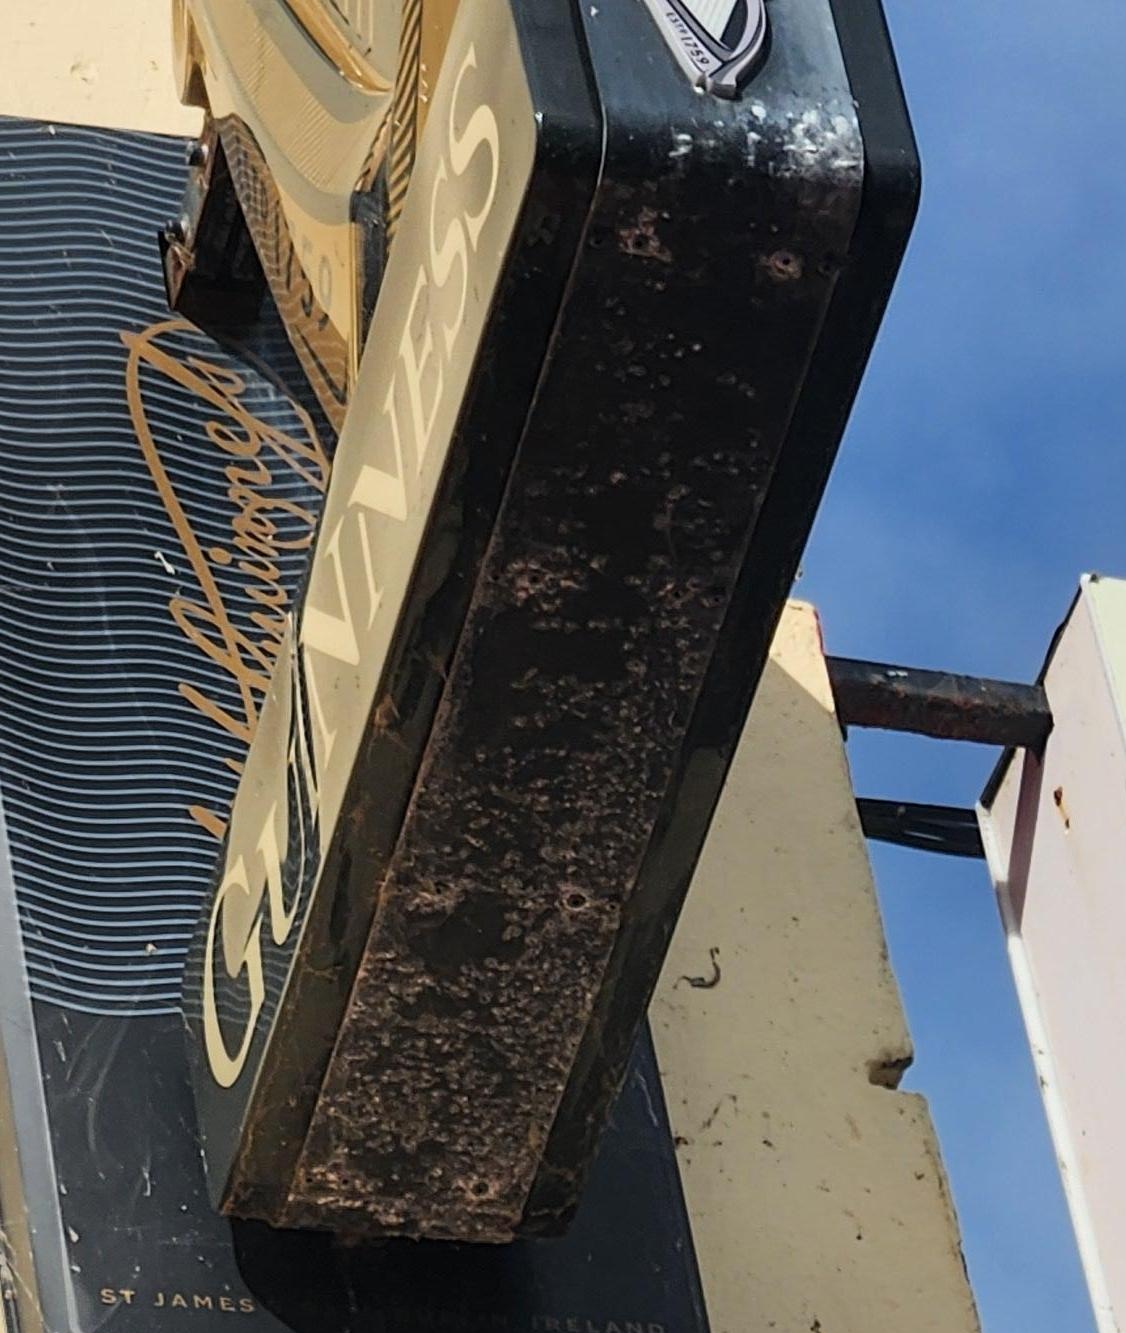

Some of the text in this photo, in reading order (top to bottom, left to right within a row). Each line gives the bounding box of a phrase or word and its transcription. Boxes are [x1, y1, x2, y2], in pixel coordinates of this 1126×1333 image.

[680, 35, 710, 66] 1759
[202, 41, 500, 1089] GUINNESS
[100, 1287, 136, 1306] ST
